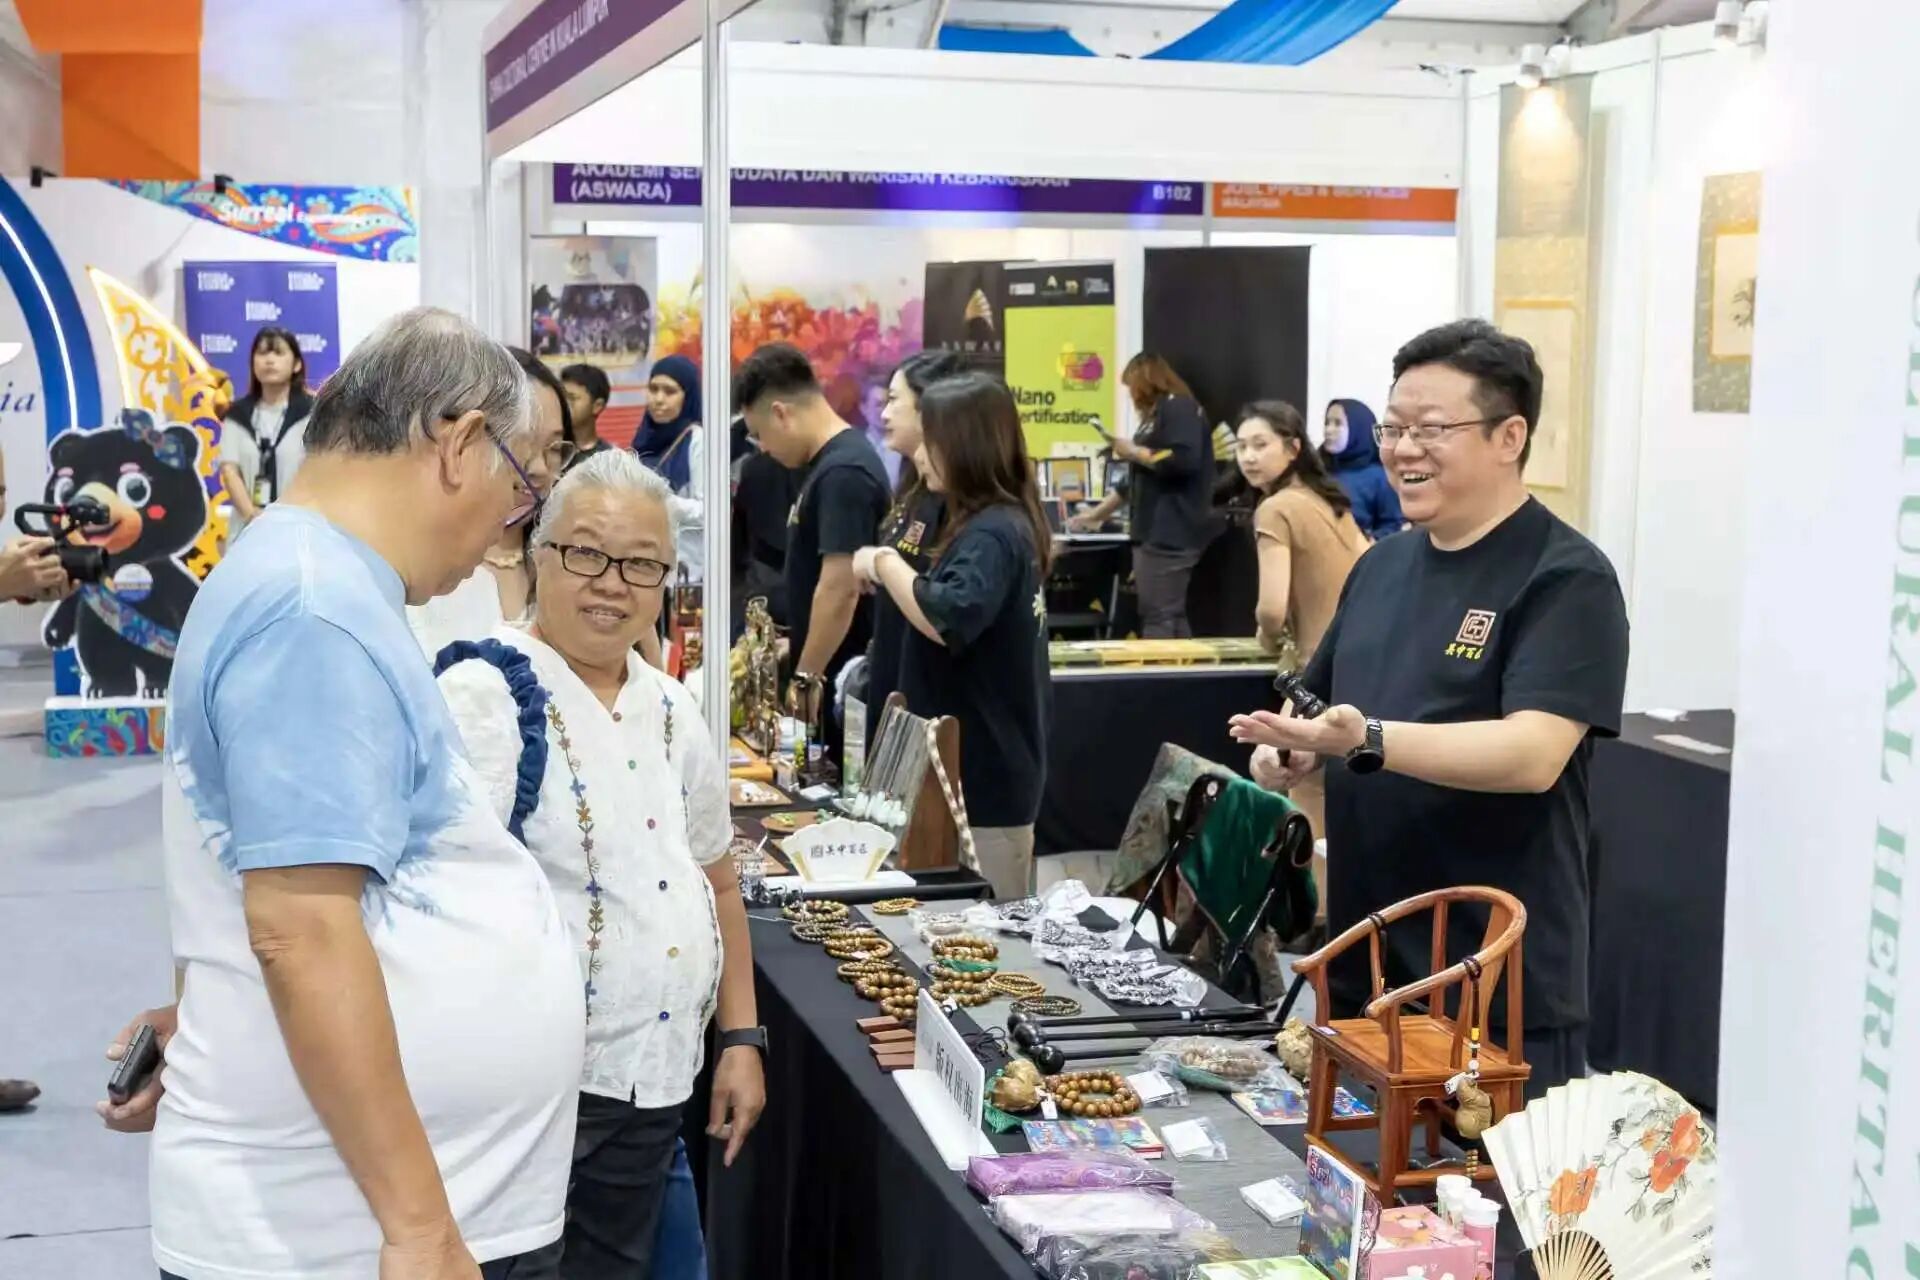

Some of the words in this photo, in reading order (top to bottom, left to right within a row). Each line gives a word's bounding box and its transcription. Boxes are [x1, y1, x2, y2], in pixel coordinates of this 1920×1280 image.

[730, 168, 798, 181] UDAYA
[570, 181, 673, 203] (ASWARA)
[1152, 185, 1192, 200] B102
[1020, 409, 1100, 424] ertification
